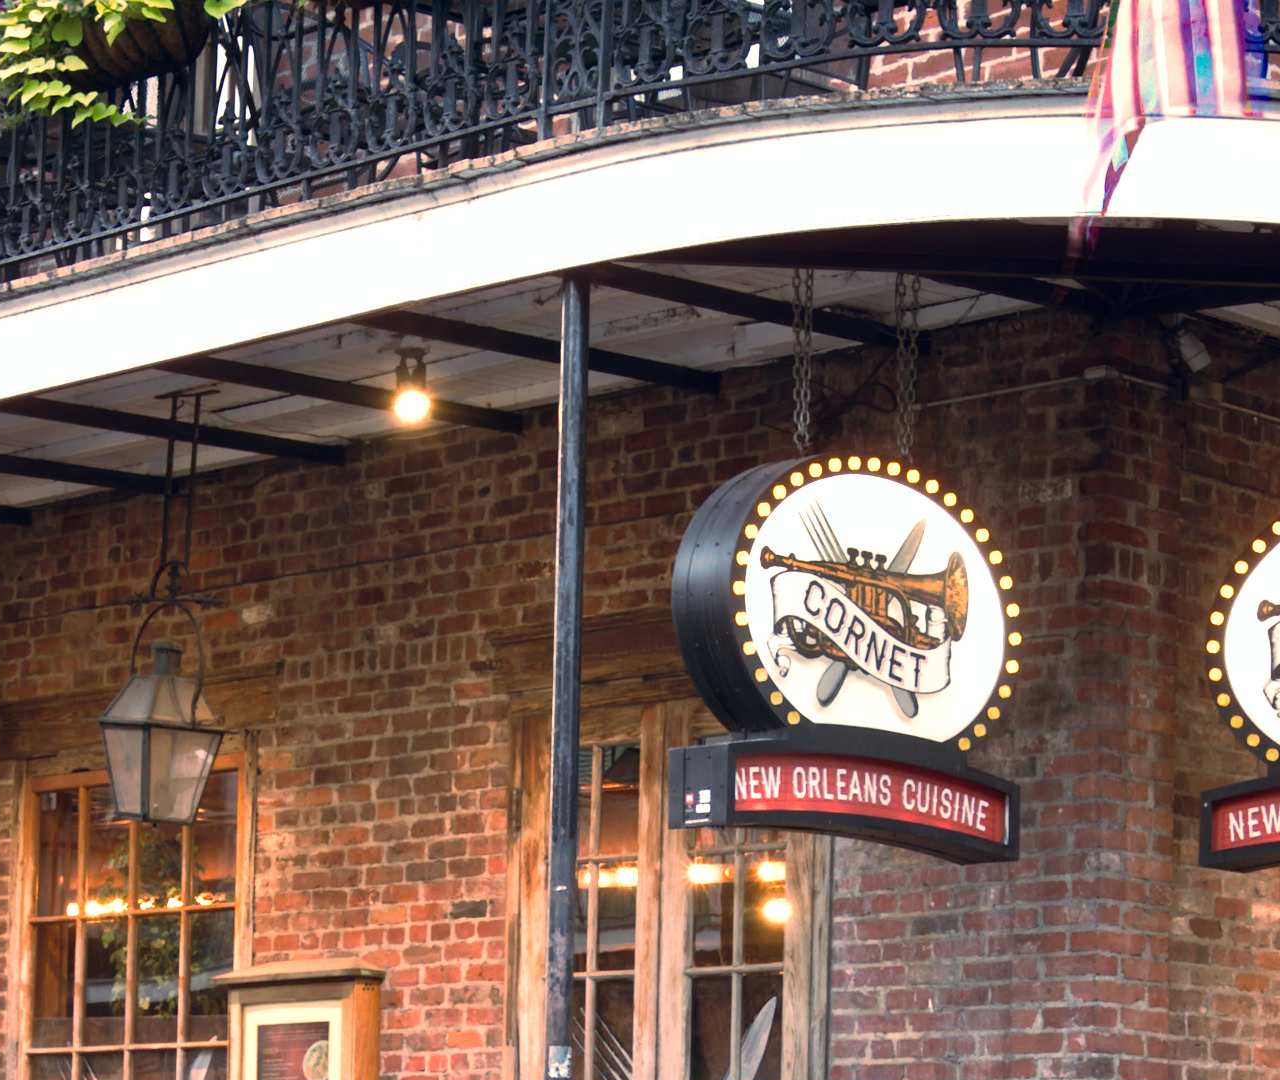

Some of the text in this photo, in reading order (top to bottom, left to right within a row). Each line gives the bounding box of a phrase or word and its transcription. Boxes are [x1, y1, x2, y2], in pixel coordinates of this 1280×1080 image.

[803, 579, 927, 688] CORNET
[734, 765, 990, 832] NEW ORLEANS CUISINE
